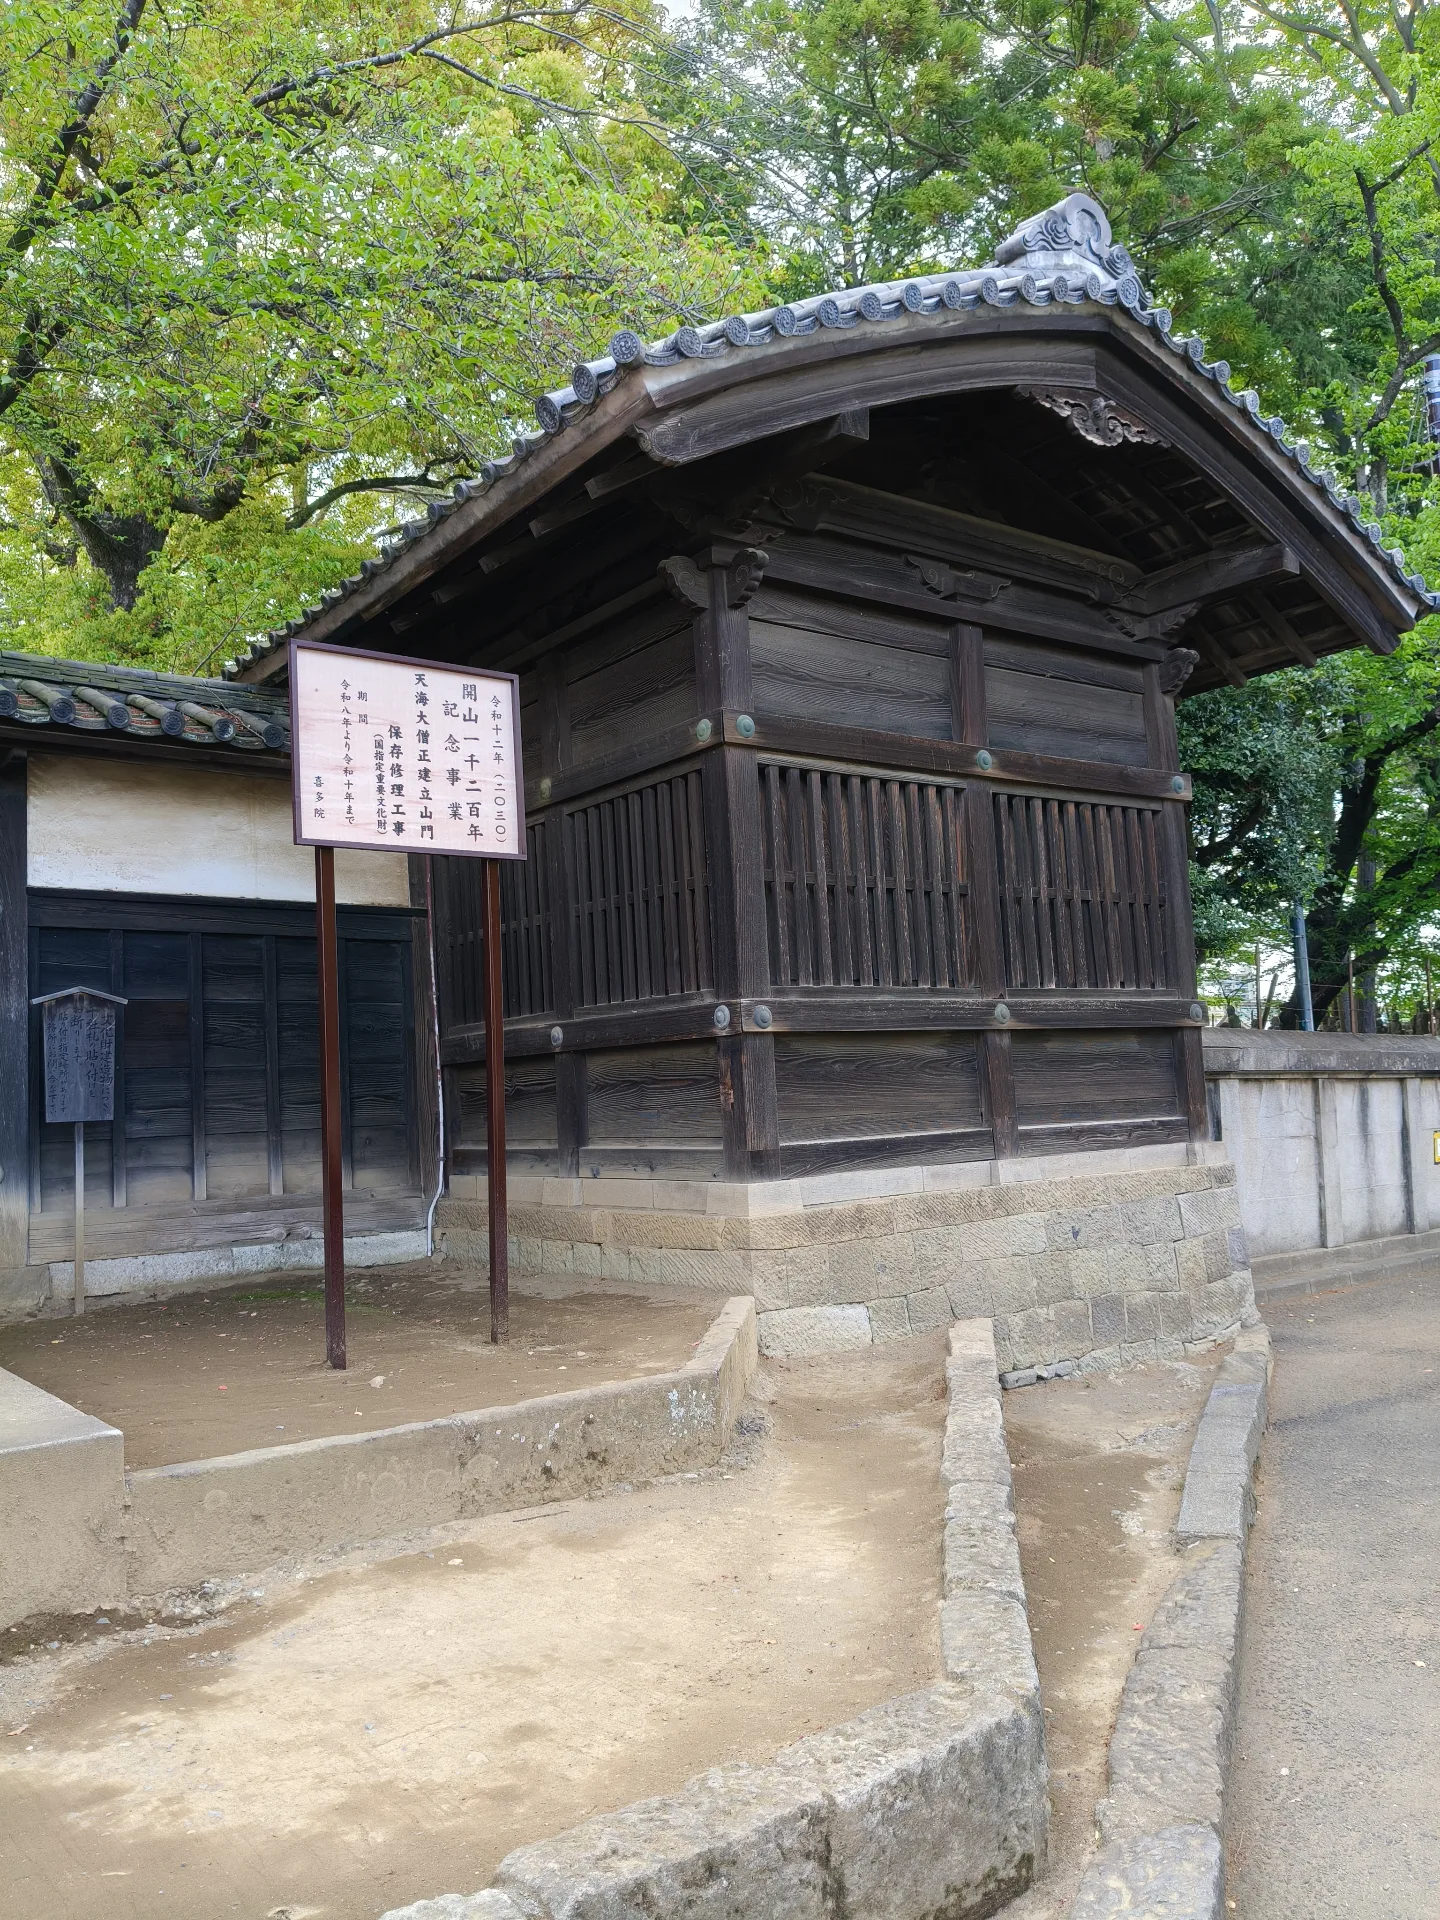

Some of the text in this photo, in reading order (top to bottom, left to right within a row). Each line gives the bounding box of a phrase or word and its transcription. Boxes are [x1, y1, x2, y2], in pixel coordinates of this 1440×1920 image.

[340, 679, 355, 825] 令和八年より令和十年まで
[357, 691, 369, 725] 期間
[414, 673, 434, 840] 天海大僧正建立山門
[442, 700, 464, 821] 記念事業
[462, 683, 483, 842] 開山一千二百年
[313, 775, 325, 819] 喜多院
[373, 734, 387, 835] （国指定重要文化財）
[388, 725, 406, 837] 保存修理工事
